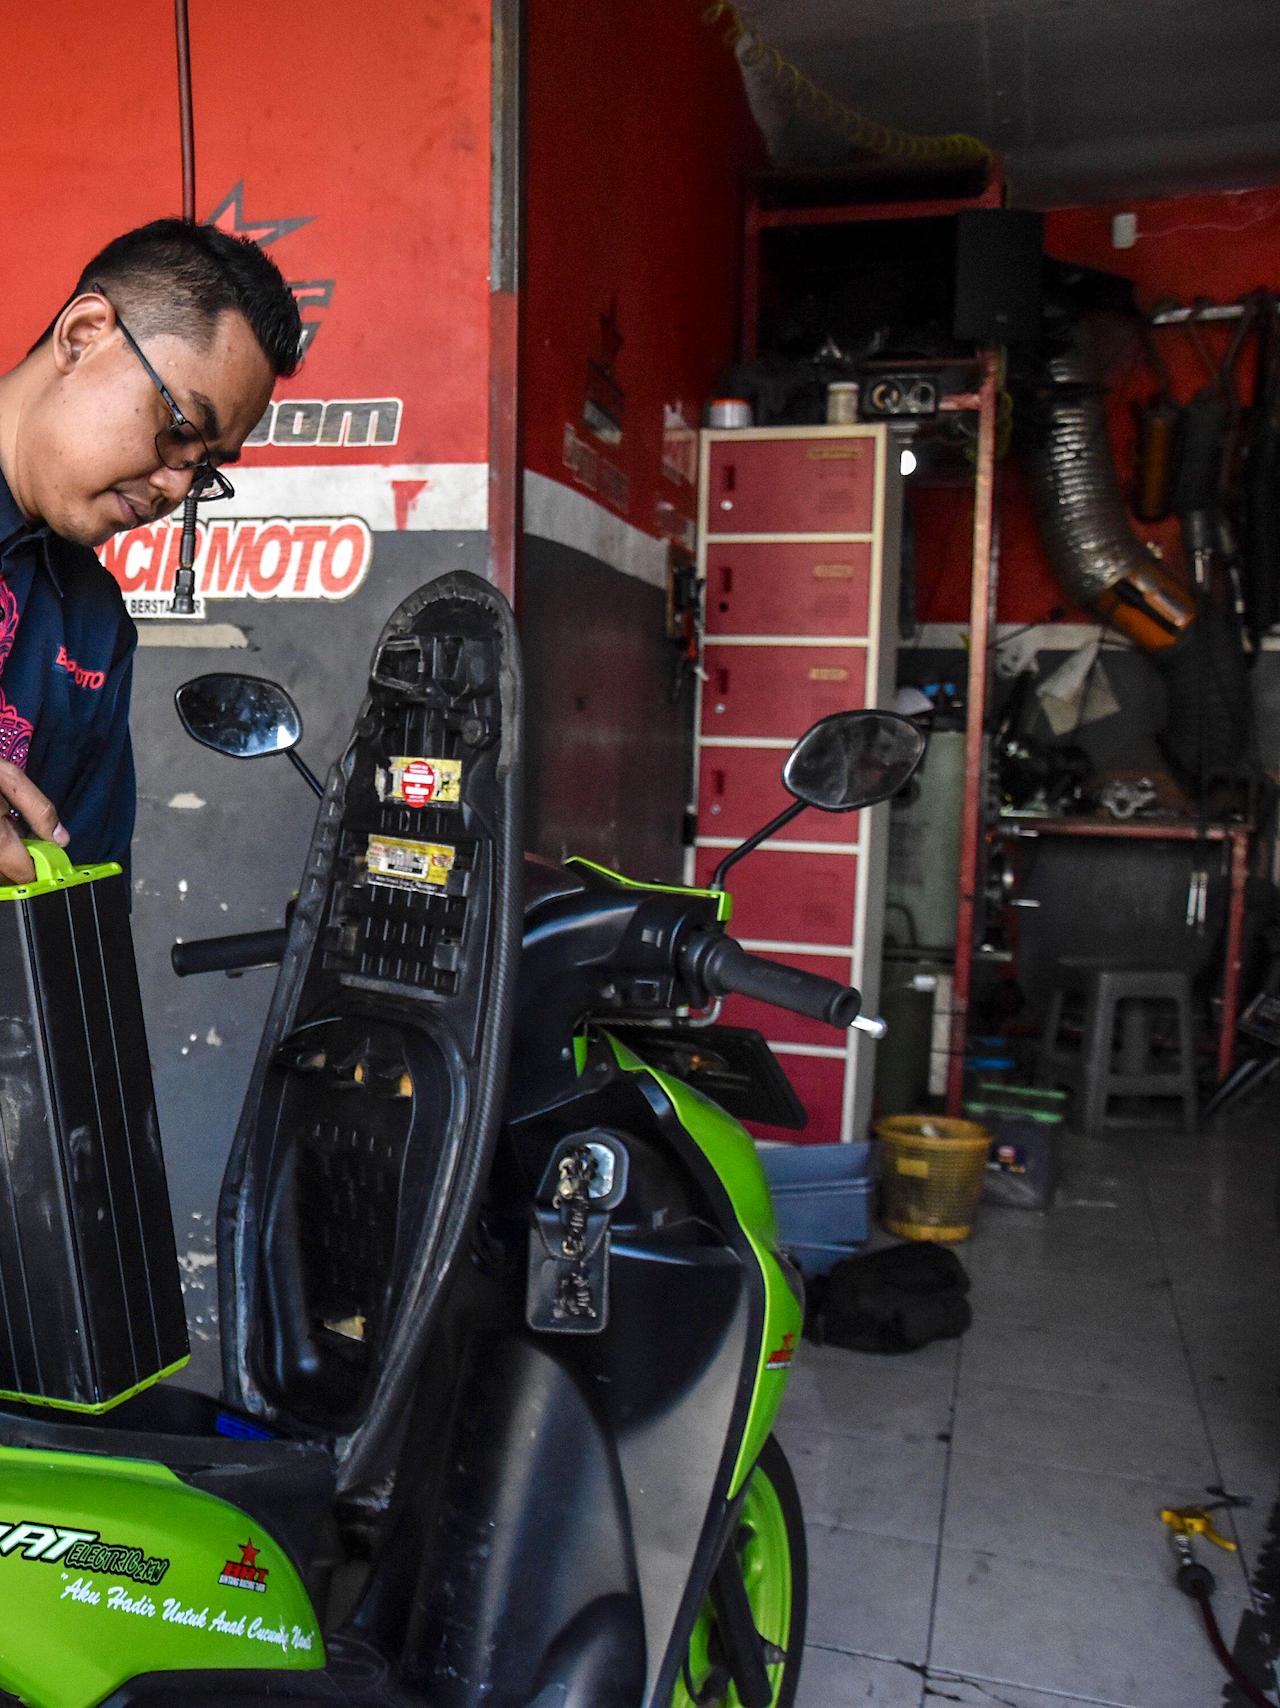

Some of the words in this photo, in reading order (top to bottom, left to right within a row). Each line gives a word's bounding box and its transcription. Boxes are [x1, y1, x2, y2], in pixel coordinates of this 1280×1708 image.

[244, 398, 403, 446] om
[200, 524, 365, 593] MOTO
[130, 600, 201, 613] BERSTAR
[65, 1542, 142, 1574] ELECTRIC
[107, 1586, 156, 1617] Hadir
[162, 1598, 209, 1628] Untuk
[208, 1610, 247, 1636] Anak
